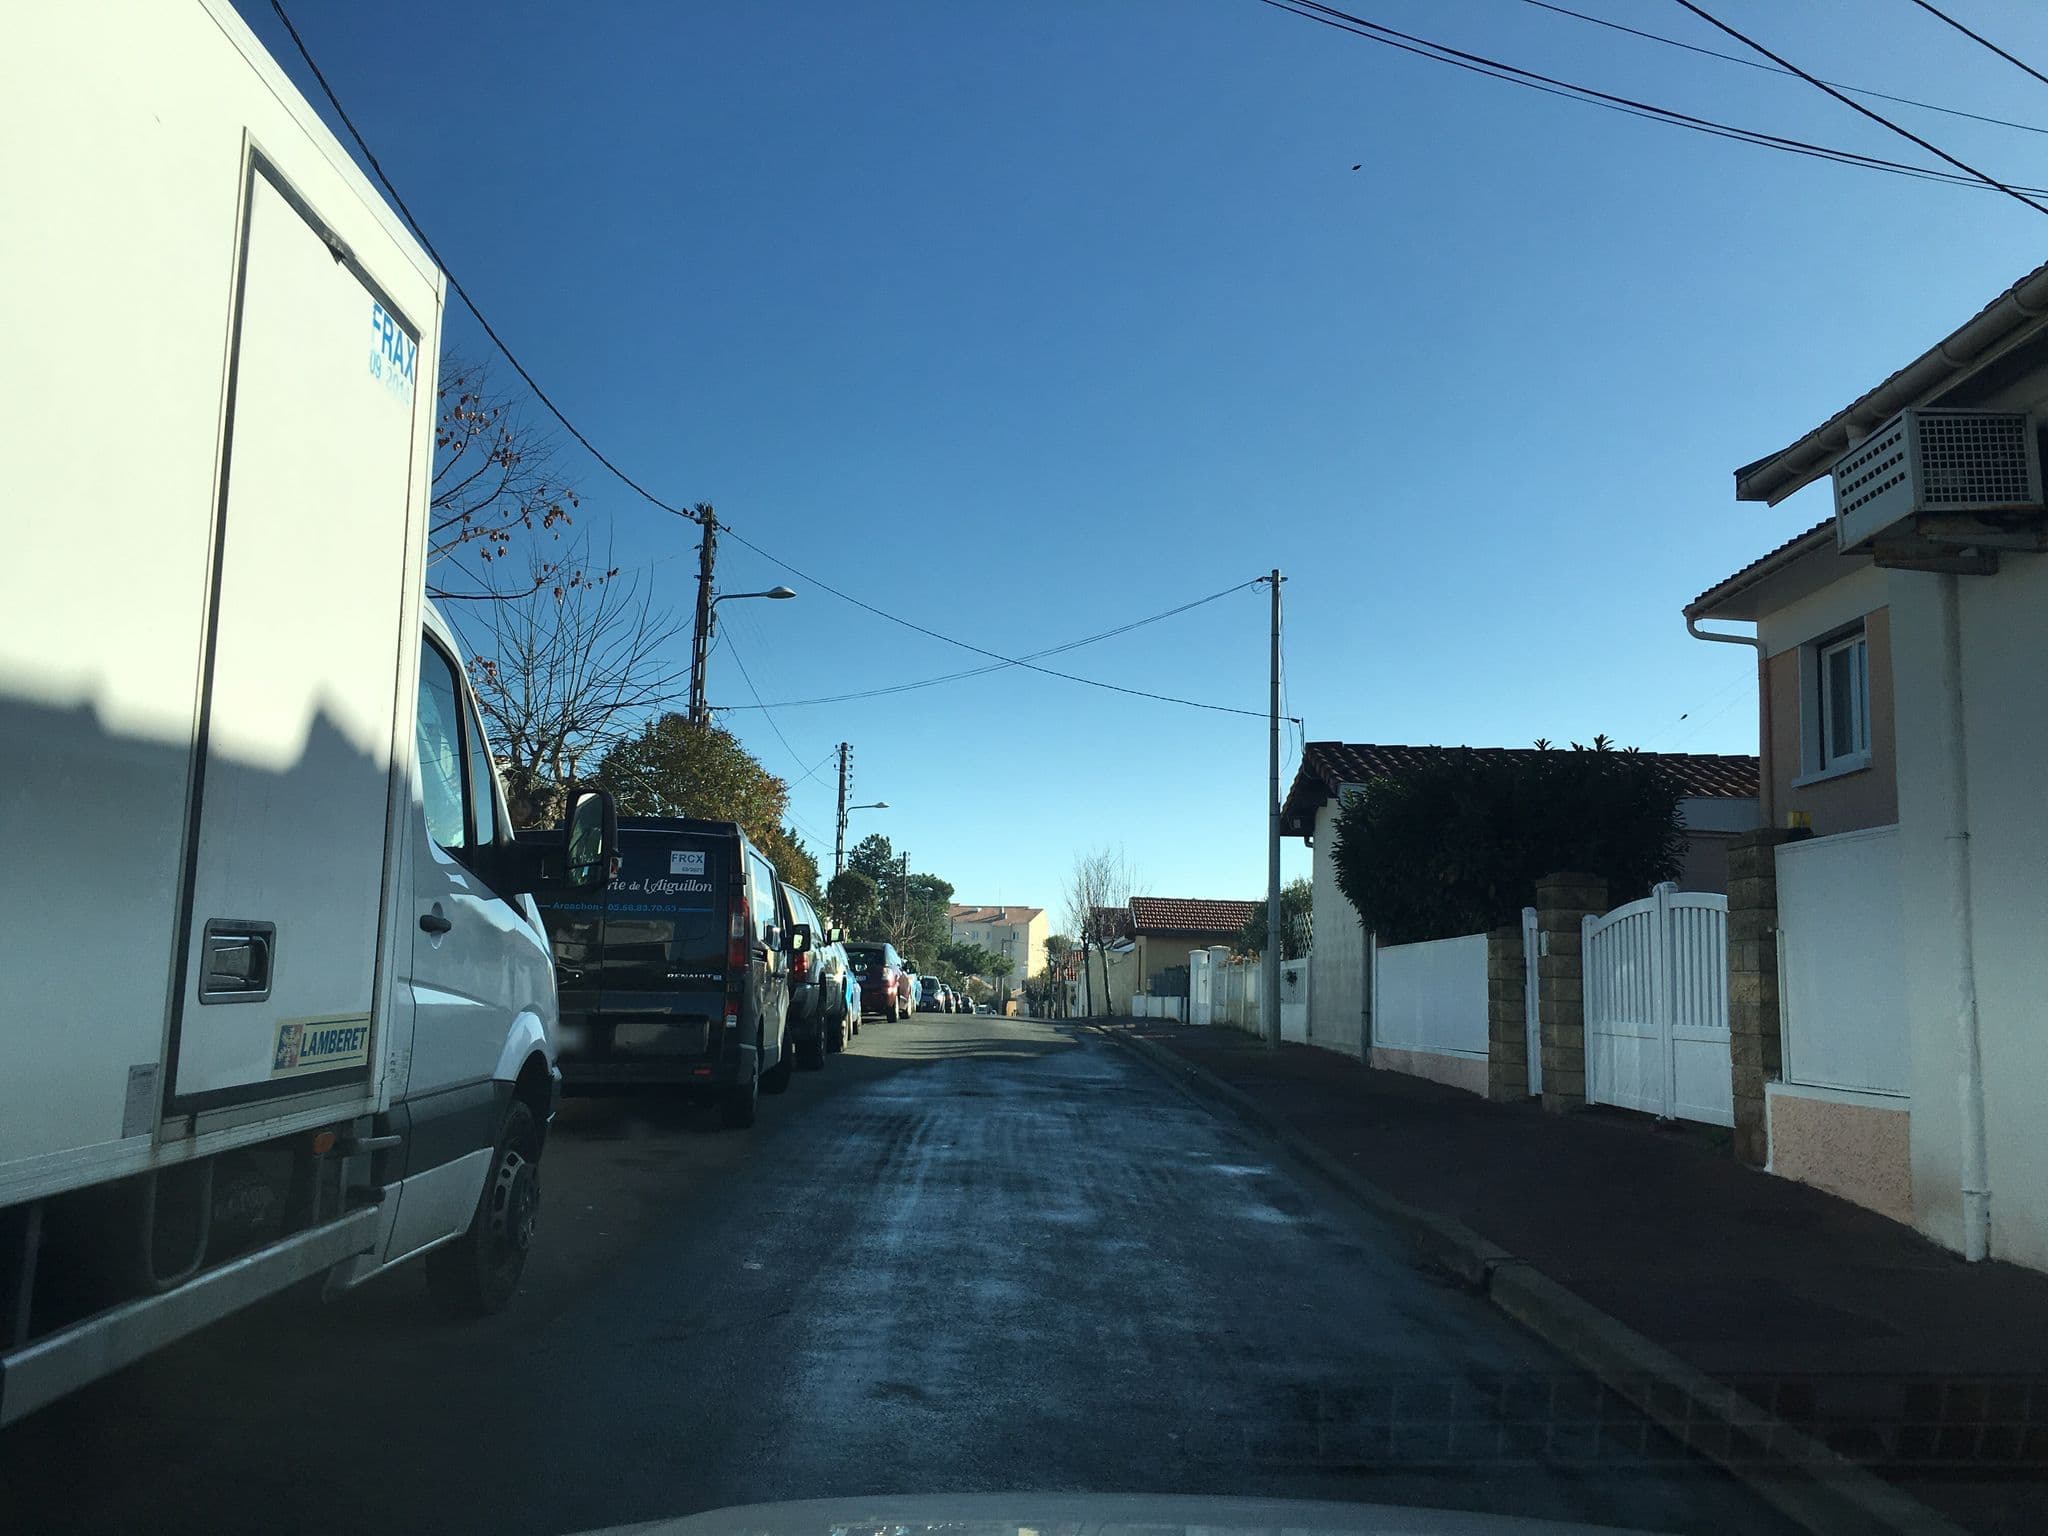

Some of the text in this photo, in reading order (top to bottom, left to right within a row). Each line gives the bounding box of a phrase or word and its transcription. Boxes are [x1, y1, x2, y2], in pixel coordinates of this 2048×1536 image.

[372, 303, 416, 385] FRAX
[671, 853, 704, 864] FRCX
[628, 881, 641, 891] de
[300, 1026, 367, 1058] LAMBERET
